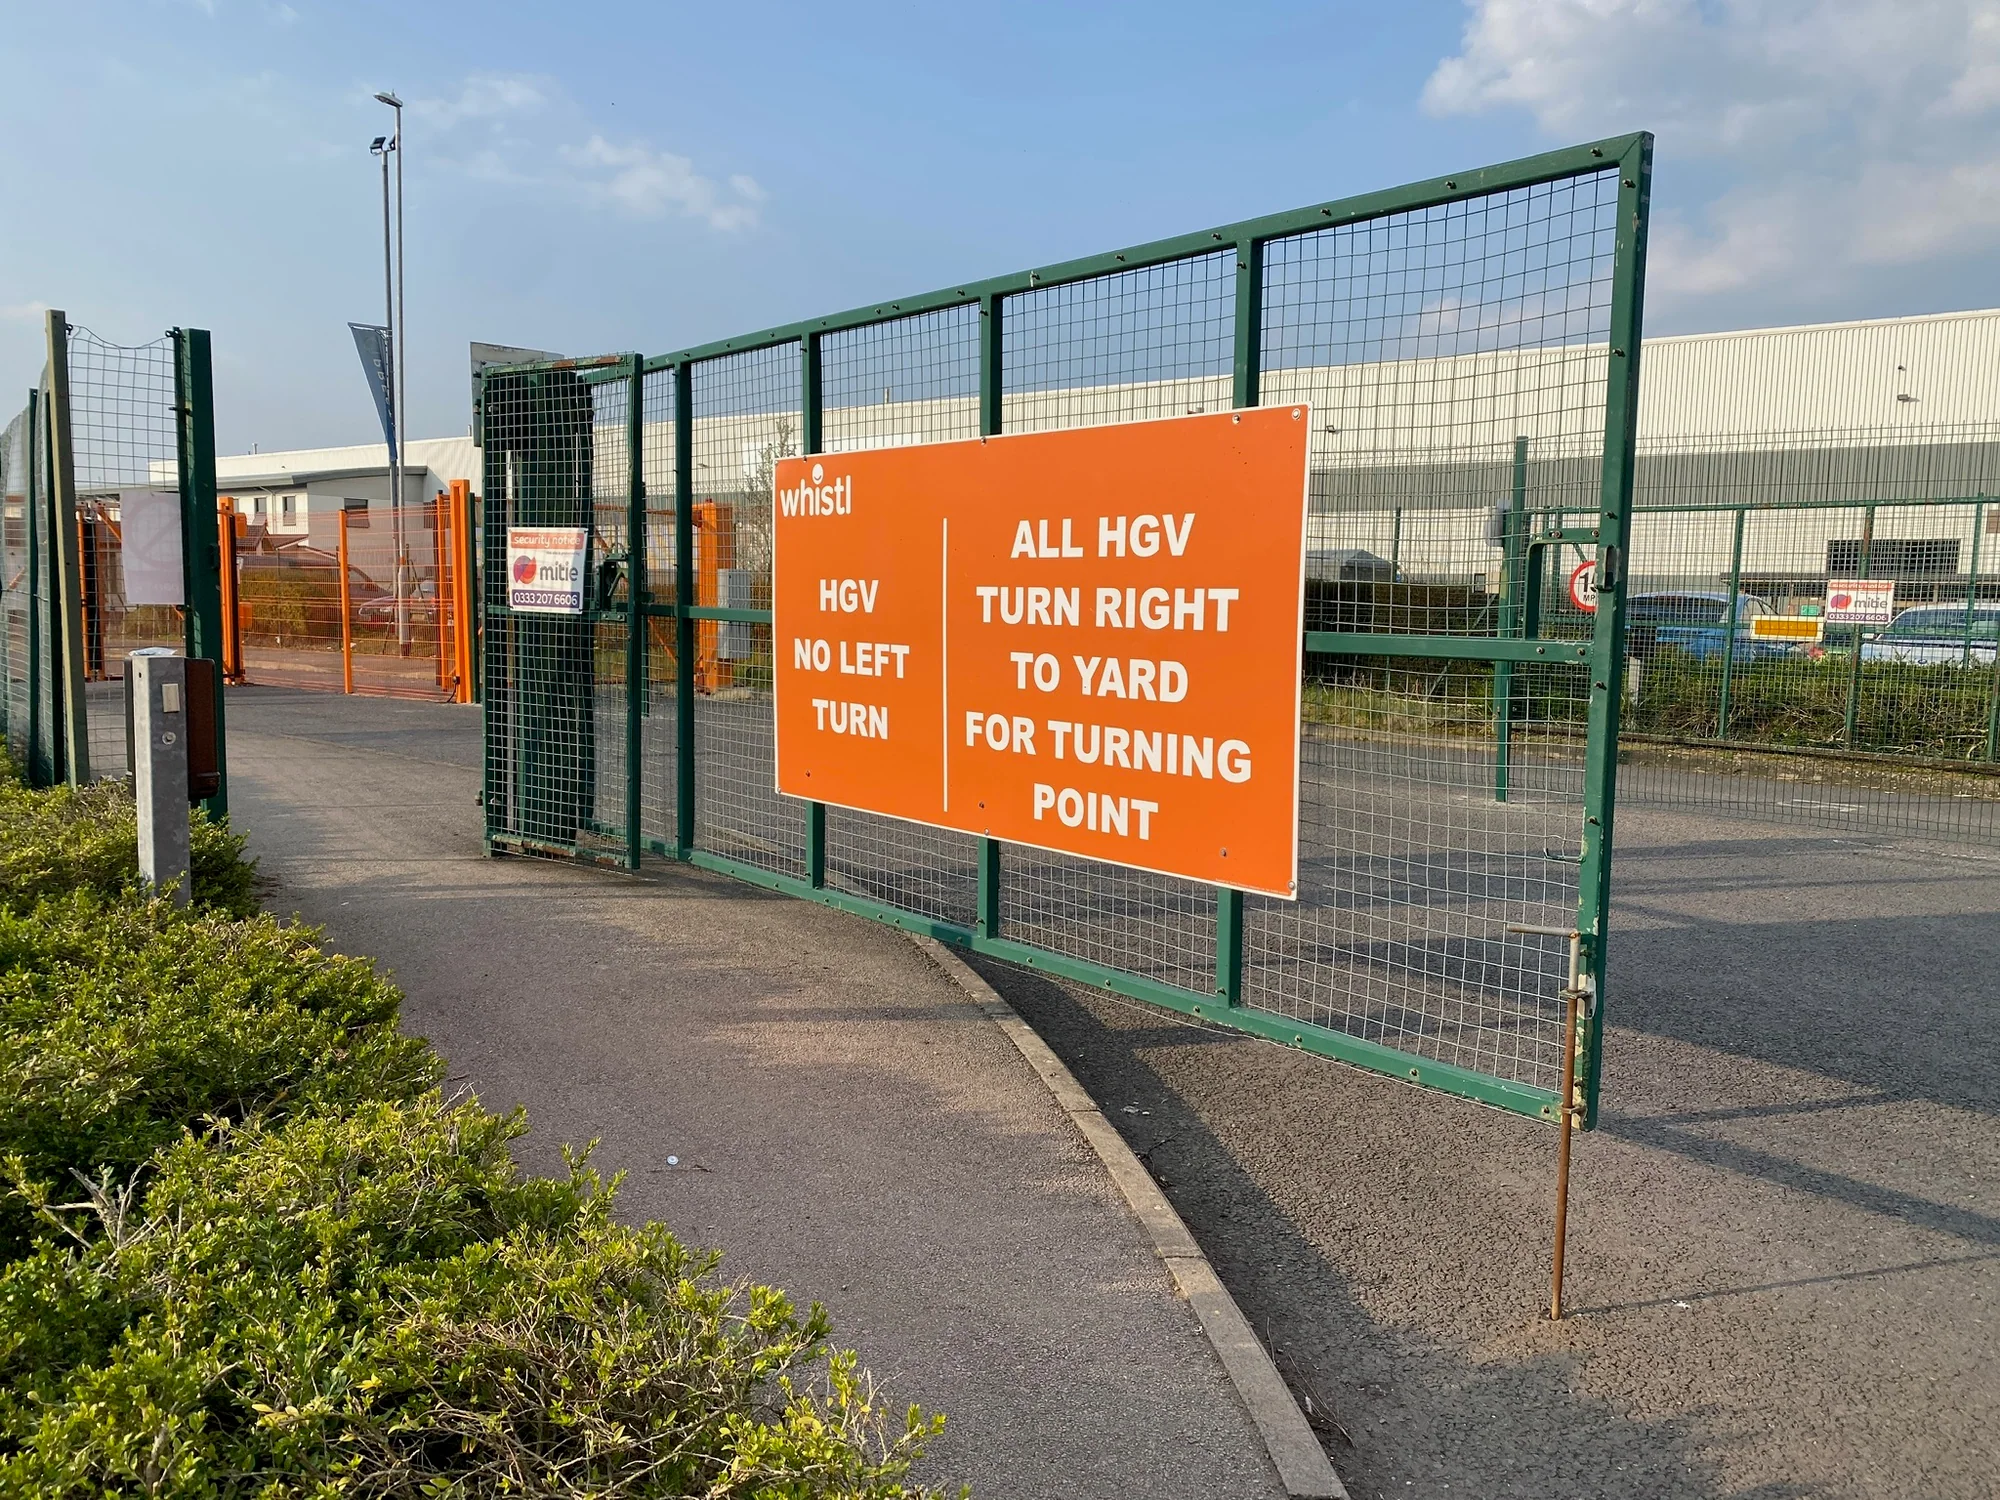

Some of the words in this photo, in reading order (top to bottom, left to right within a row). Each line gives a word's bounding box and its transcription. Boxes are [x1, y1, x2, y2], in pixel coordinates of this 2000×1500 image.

[780, 463, 851, 517] whistl
[514, 532, 551, 548] security
[552, 533, 580, 545] notice
[1010, 519, 1084, 559] ALL
[1098, 513, 1196, 558] HGV
[539, 561, 579, 581] mitie
[514, 592, 535, 604] 0333
[536, 593, 553, 604] 207
[554, 594, 578, 606] 6606
[819, 579, 879, 613] HGV
[976, 586, 1080, 626] TURN
[1095, 587, 1240, 632] RIGHT
[1854, 597, 1888, 609] mitie
[794, 638, 831, 672] NO
[840, 641, 910, 679] LEFT
[1010, 651, 1060, 692] TO
[1073, 655, 1188, 703] YARD
[812, 698, 888, 740] TURN
[966, 711, 1036, 755] FOR
[1047, 720, 1252, 783] TURNING
[1033, 783, 1159, 841] POINT
